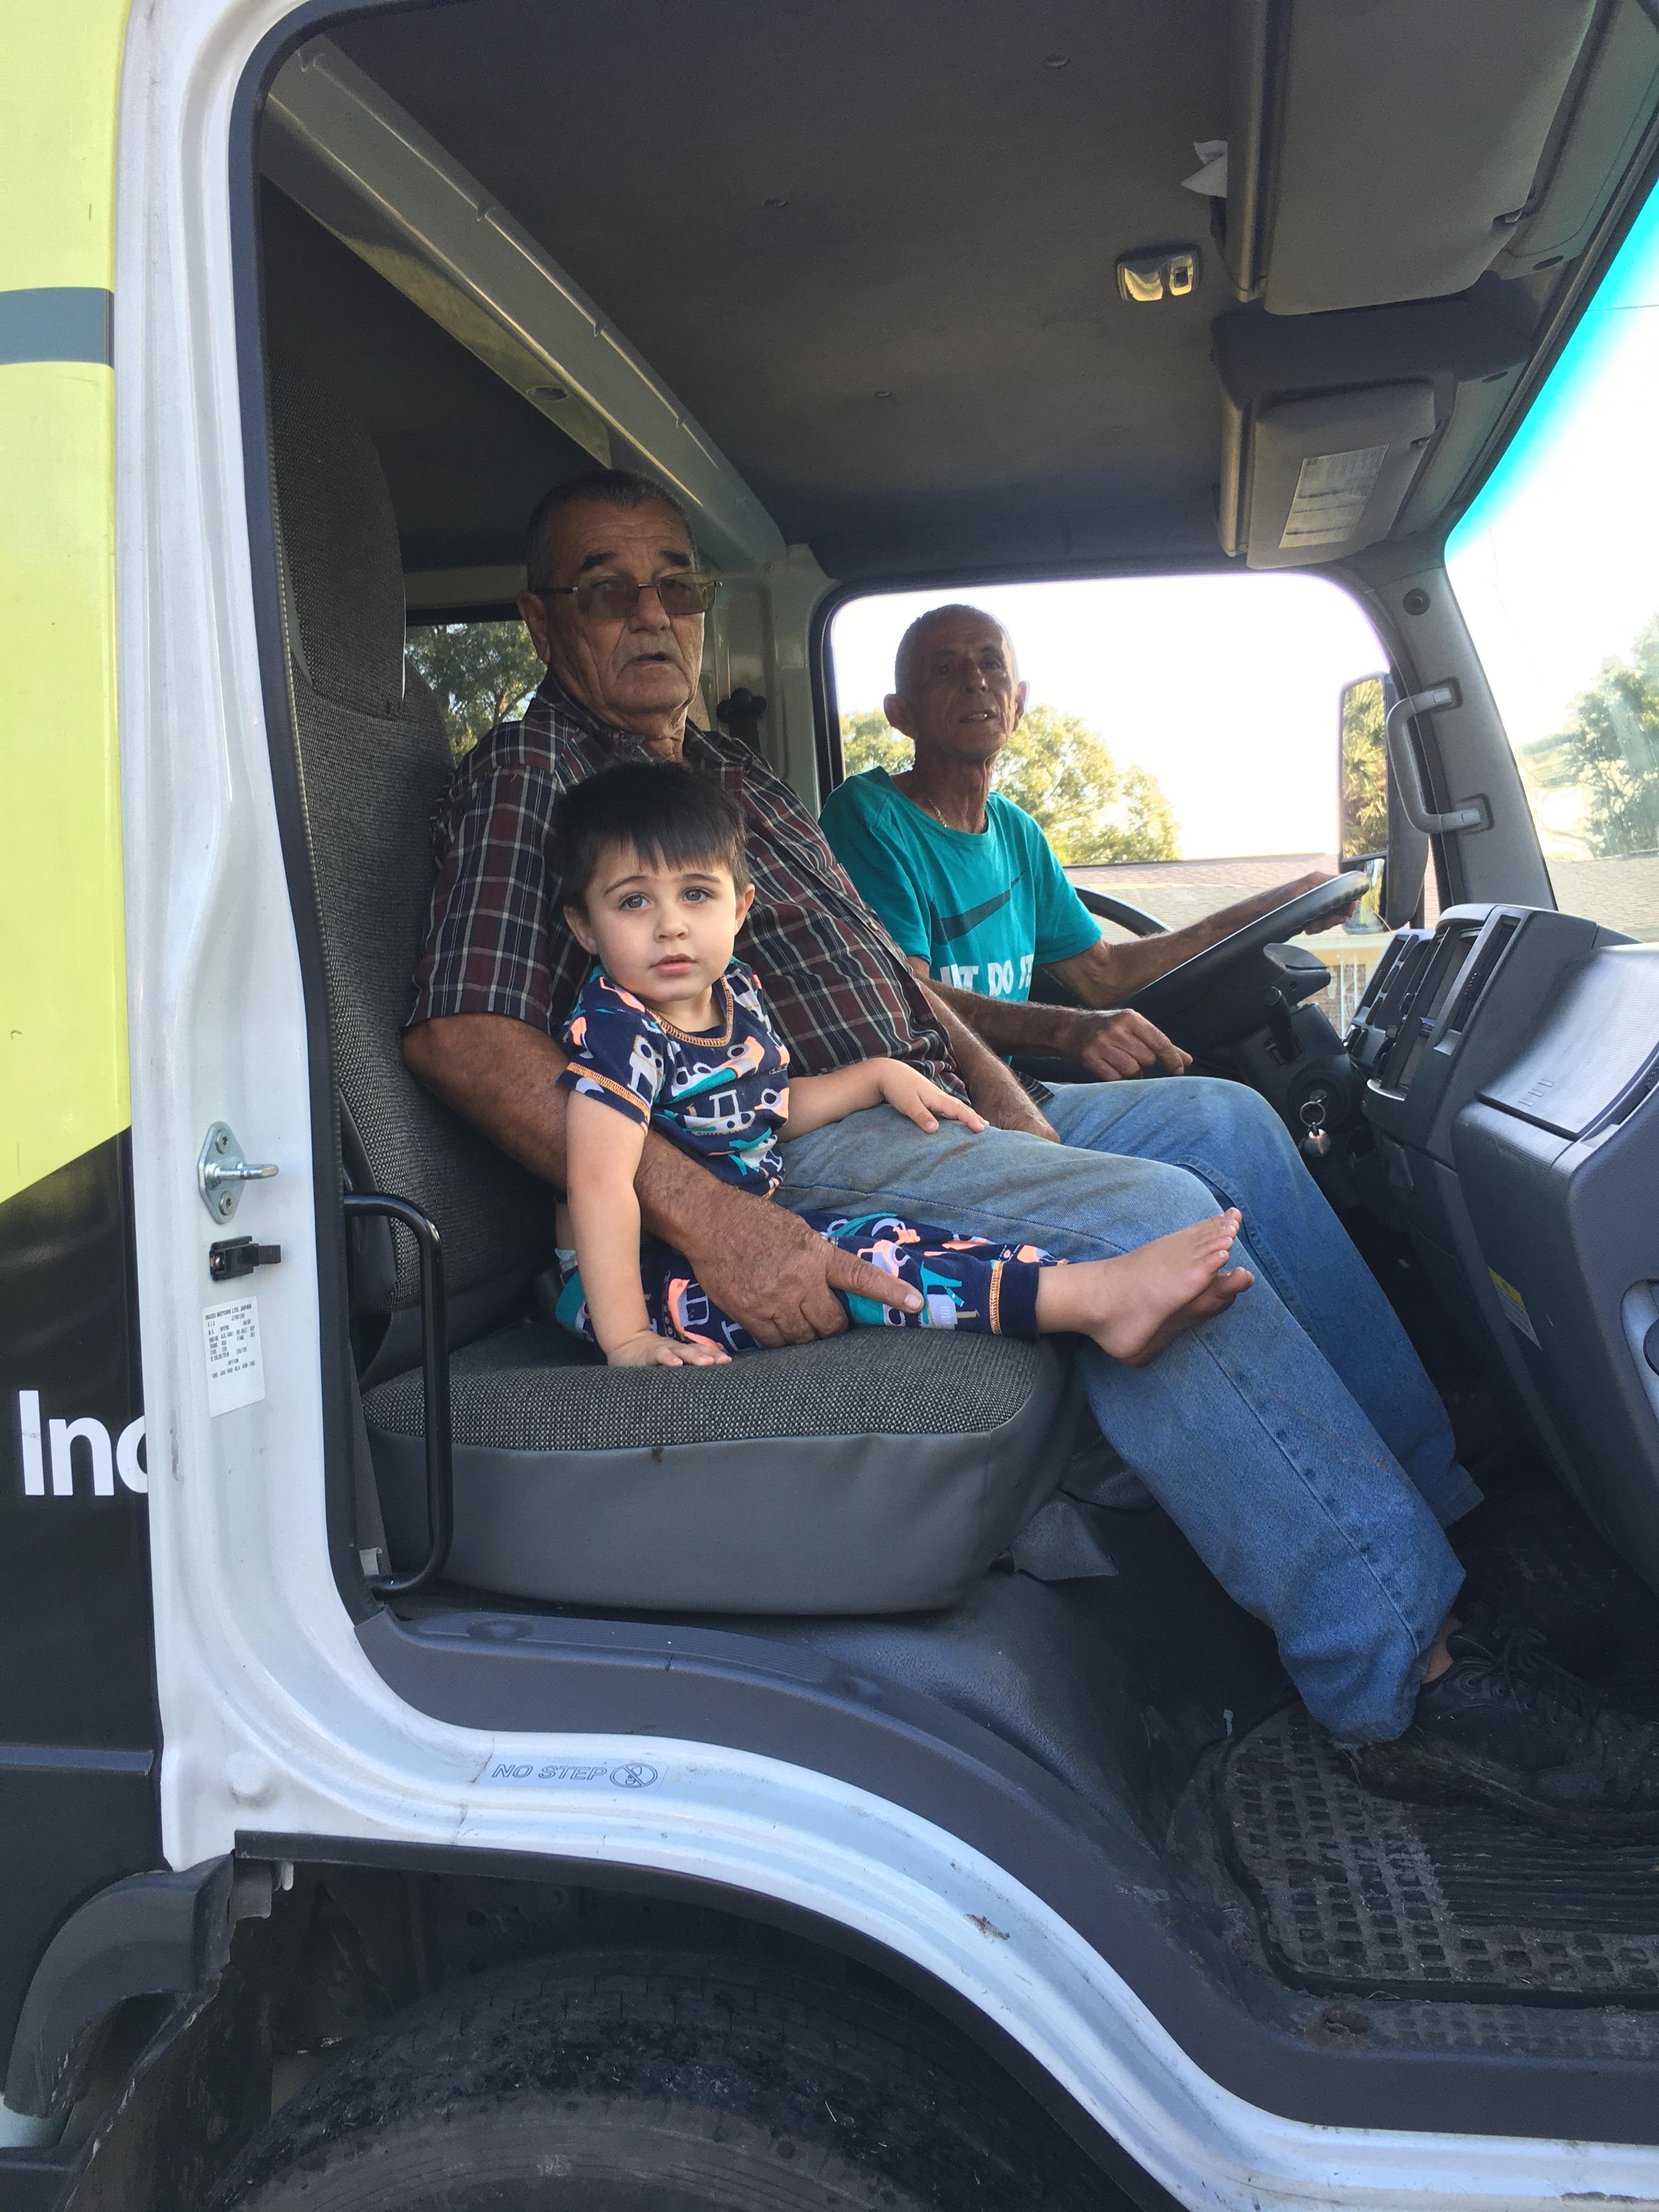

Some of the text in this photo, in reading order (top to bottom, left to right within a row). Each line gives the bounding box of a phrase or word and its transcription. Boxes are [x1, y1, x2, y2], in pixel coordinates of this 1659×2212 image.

[988, 960, 1014, 996] DO
[205, 1312, 216, 1321] ISUZU
[217, 1308, 232, 1317] MOTORS
[492, 1764, 608, 1781] NO STEP
